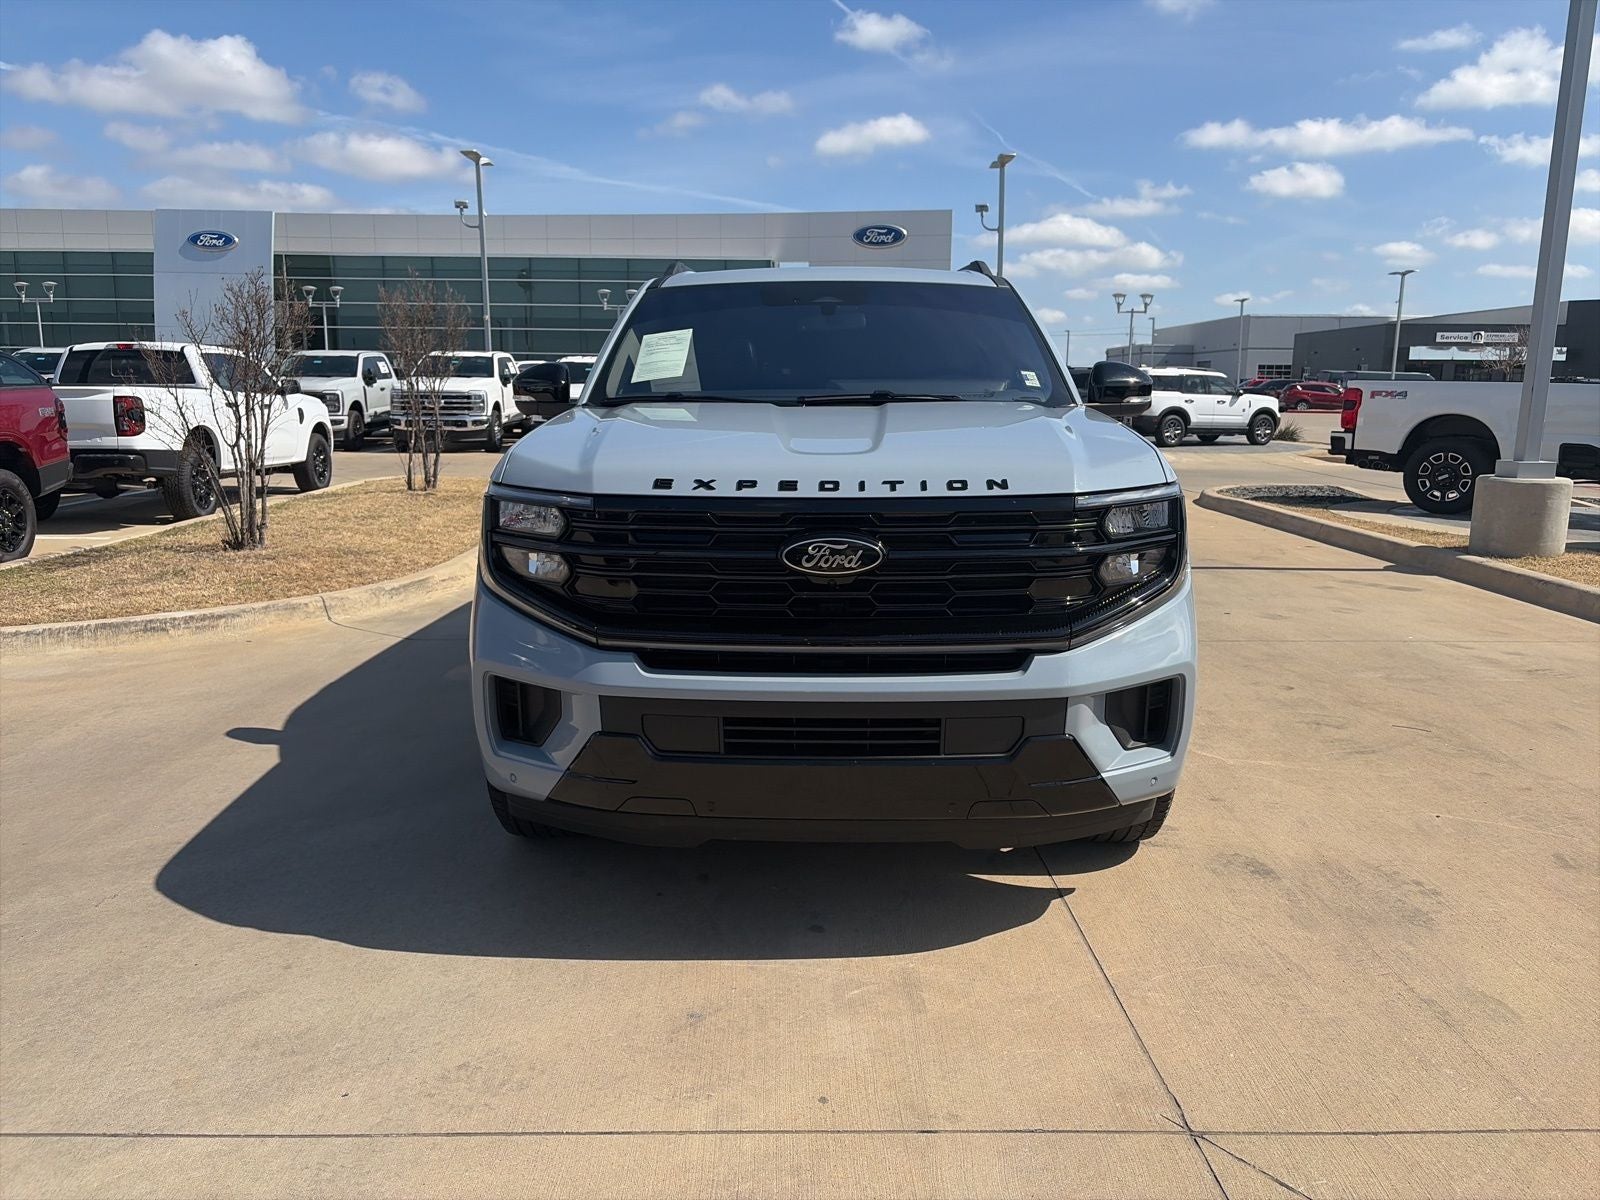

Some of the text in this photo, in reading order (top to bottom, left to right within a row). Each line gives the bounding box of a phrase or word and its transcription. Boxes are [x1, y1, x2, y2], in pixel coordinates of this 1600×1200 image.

[197, 234, 225, 246] Ford
[863, 229, 895, 243] Ford
[1370, 390, 1408, 400] FX4
[652, 478, 1009, 492] EXPEDITION
[801, 543, 863, 568] Ford
